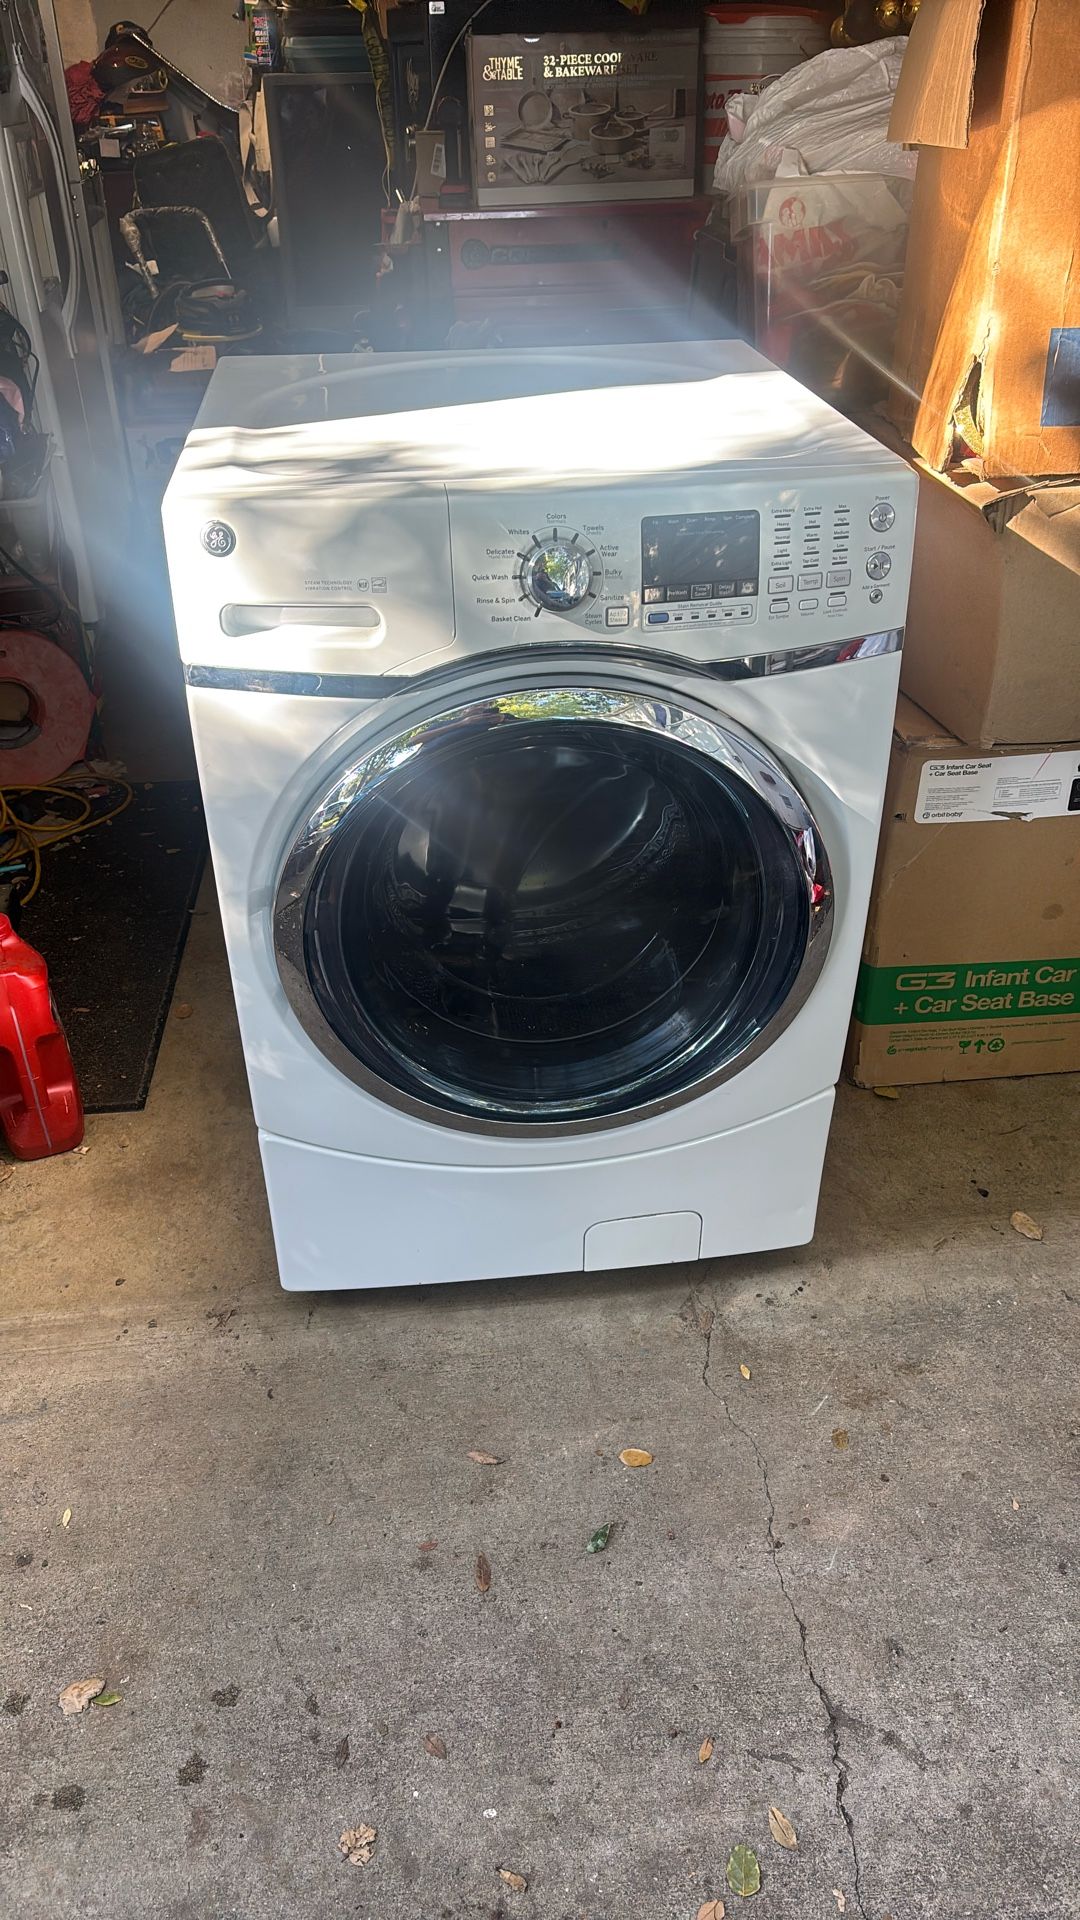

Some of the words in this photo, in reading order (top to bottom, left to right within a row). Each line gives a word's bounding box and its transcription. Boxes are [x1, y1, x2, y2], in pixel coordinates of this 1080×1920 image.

[488, 56, 522, 69] THYME
[544, 54, 592, 66] 32-PIECE
[496, 68, 524, 80] TABLE
[544, 66, 554, 78] &
[555, 64, 618, 78] BAKEWARE
[896, 971, 956, 991] G3
[965, 969, 1031, 988] Infant
[1035, 966, 1077, 984] Car
[894, 1002, 908, 1014] +
[914, 996, 958, 1013] Car
[961, 993, 1014, 1012] Seat
[1018, 991, 1075, 1008] Base
